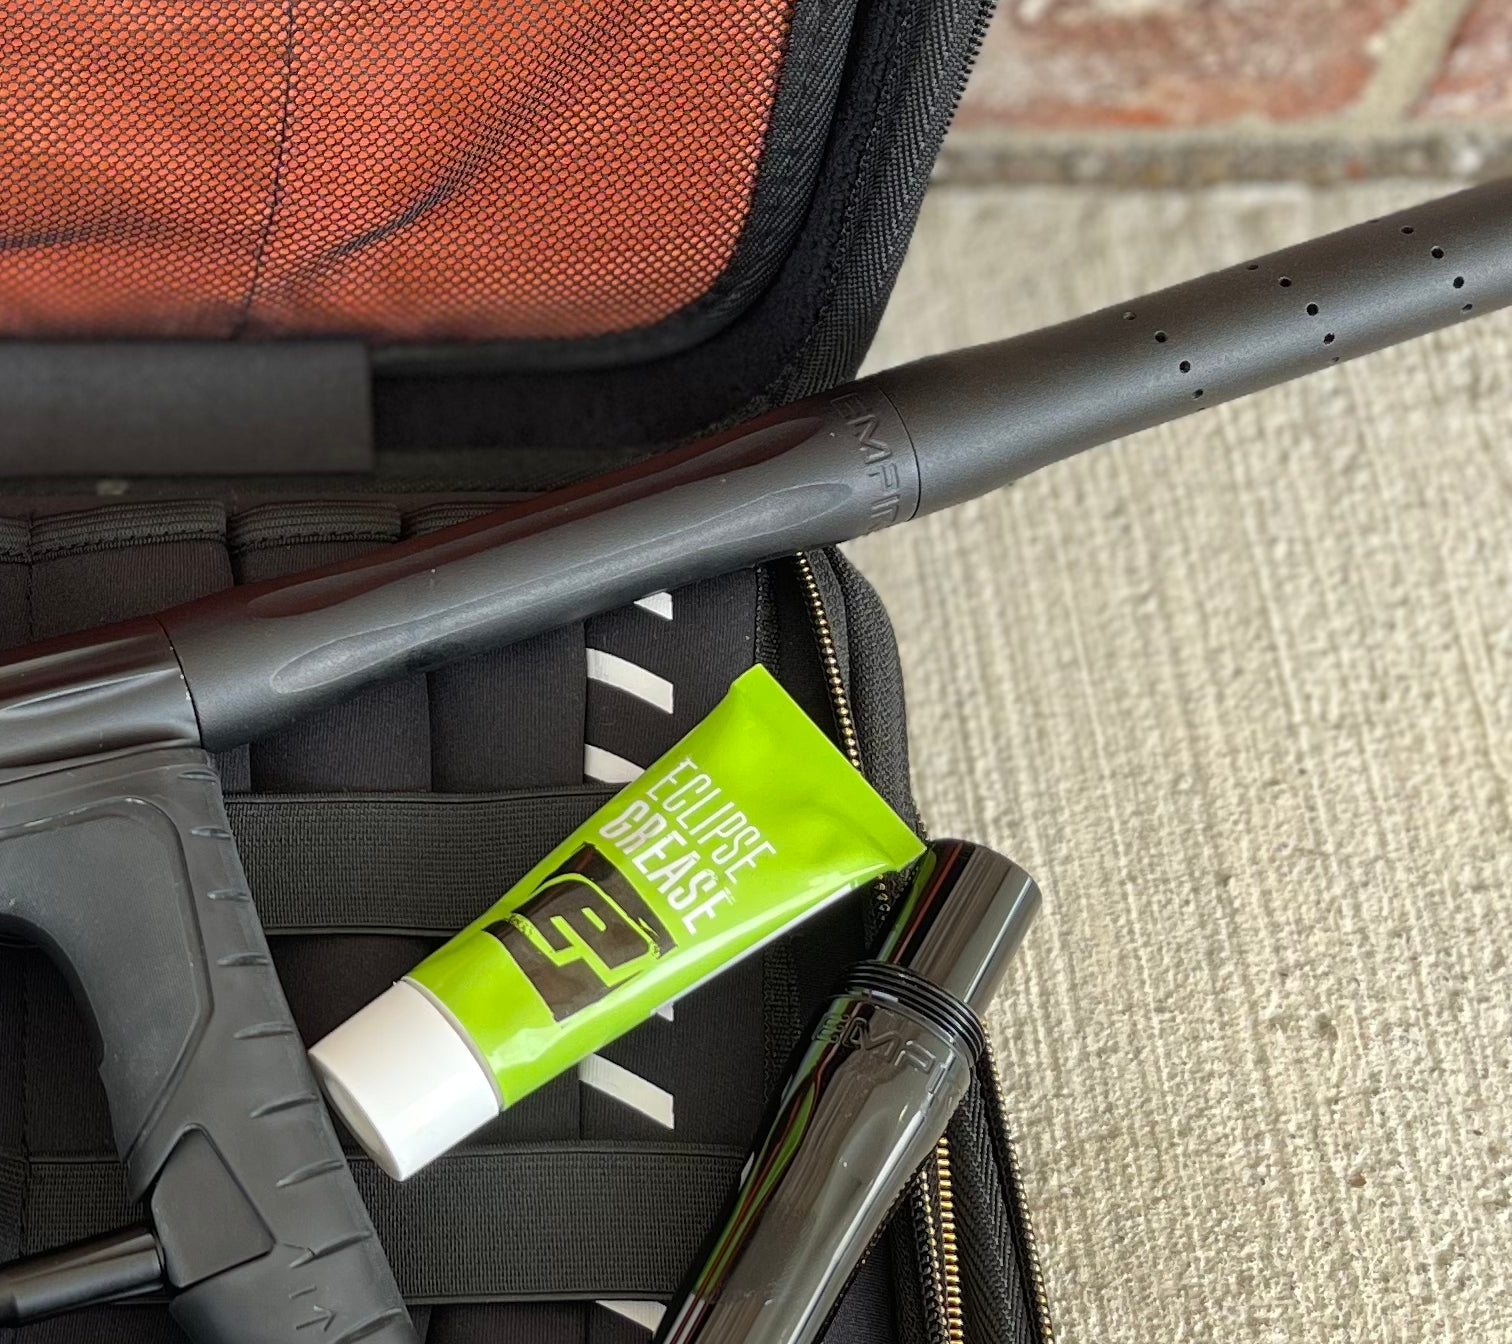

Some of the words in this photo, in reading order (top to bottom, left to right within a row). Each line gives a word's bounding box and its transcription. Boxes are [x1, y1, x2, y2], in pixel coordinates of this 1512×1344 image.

[598, 799, 736, 936] GREASE
[645, 754, 777, 885] ECLIPSE
[812, 1013, 952, 1098] EMPI
